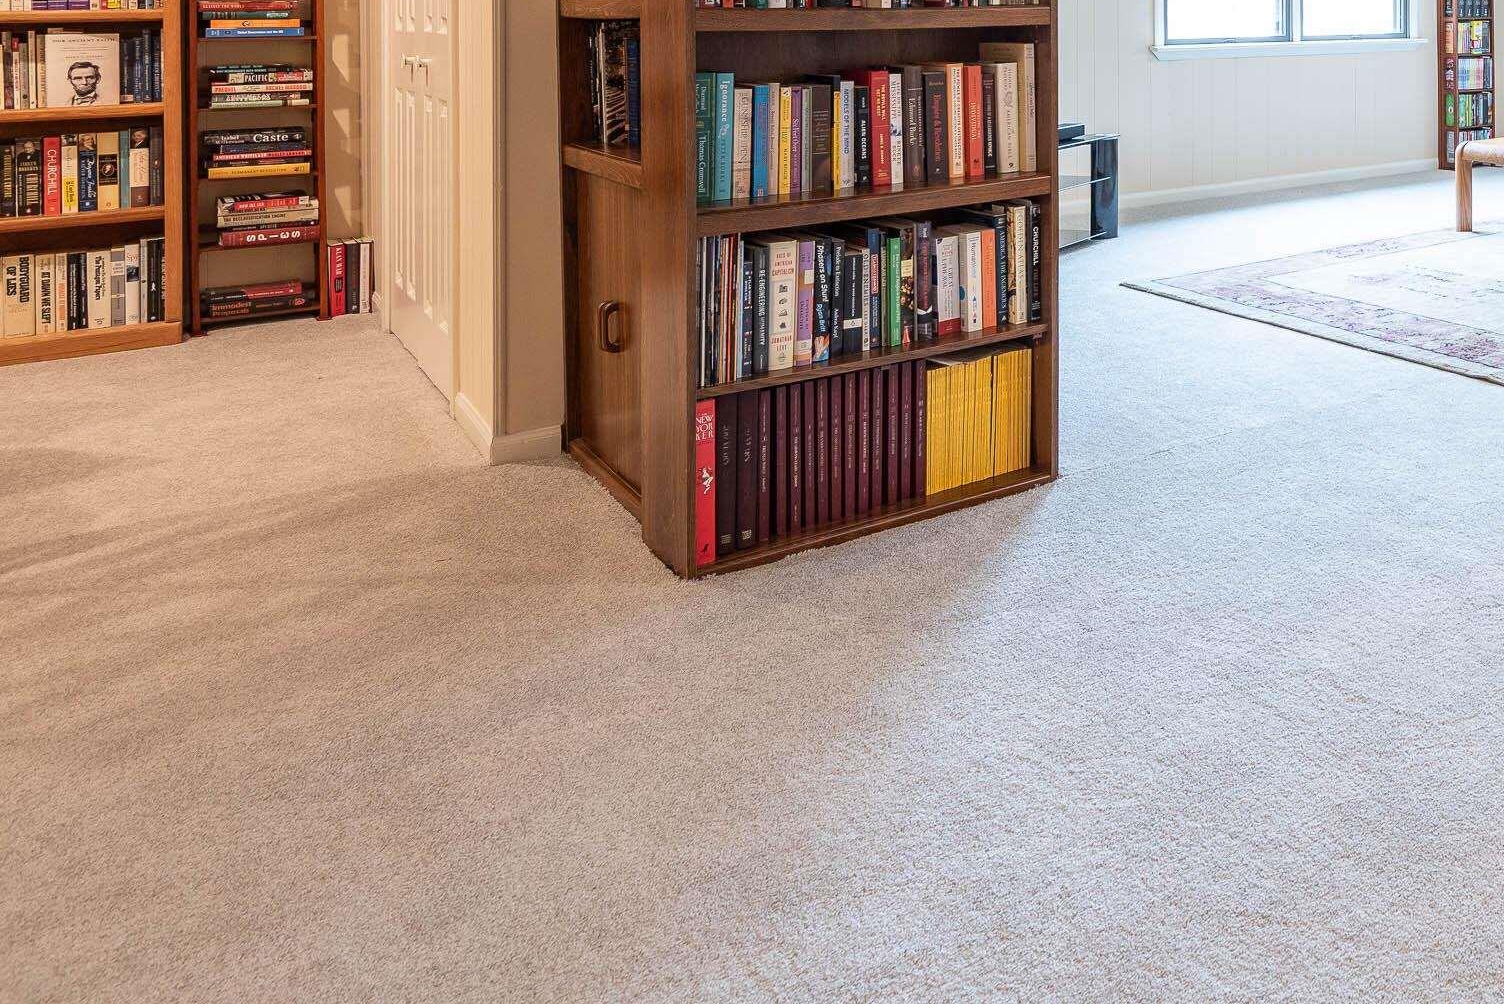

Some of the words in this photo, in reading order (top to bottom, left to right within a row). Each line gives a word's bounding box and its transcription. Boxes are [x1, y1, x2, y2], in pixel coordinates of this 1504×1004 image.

[244, 74, 269, 83] PACIFIC
[719, 80, 731, 122] Ignorance
[740, 96, 749, 114] GUN
[843, 114, 850, 123] OF
[908, 97, 917, 126] Edmund
[968, 100, 976, 141] INDIVIDUAL
[252, 133, 289, 143] Caste
[740, 120, 749, 138] SHIP
[908, 126, 917, 146] Burke
[698, 136, 707, 161] Thomas
[740, 146, 749, 161] PEN
[47, 149, 57, 196] CHURCHILL
[698, 161, 707, 193] Cromwell
[246, 230, 301, 243] SPIES
[1017, 217, 1026, 252] GOLDEN
[94, 255, 103, 265] The
[816, 245, 827, 273] Phasers
[1017, 253, 1026, 280] ATLAS
[6, 266, 17, 276] OF
[19, 256, 30, 303] BODYGUARD
[94, 264, 103, 285] Pentagon
[819, 274, 826, 283] on
[6, 277, 17, 297] LIES
[40, 279, 51, 297] DAWN
[94, 285, 103, 301] Papers
[757, 269, 766, 317] RE-ENGINEERING
[40, 297, 51, 307] WE
[815, 303, 825, 318] Ryan
[40, 307, 51, 325] SLEPT
[818, 318, 826, 332] Britt
[695, 414, 714, 424] NEW
